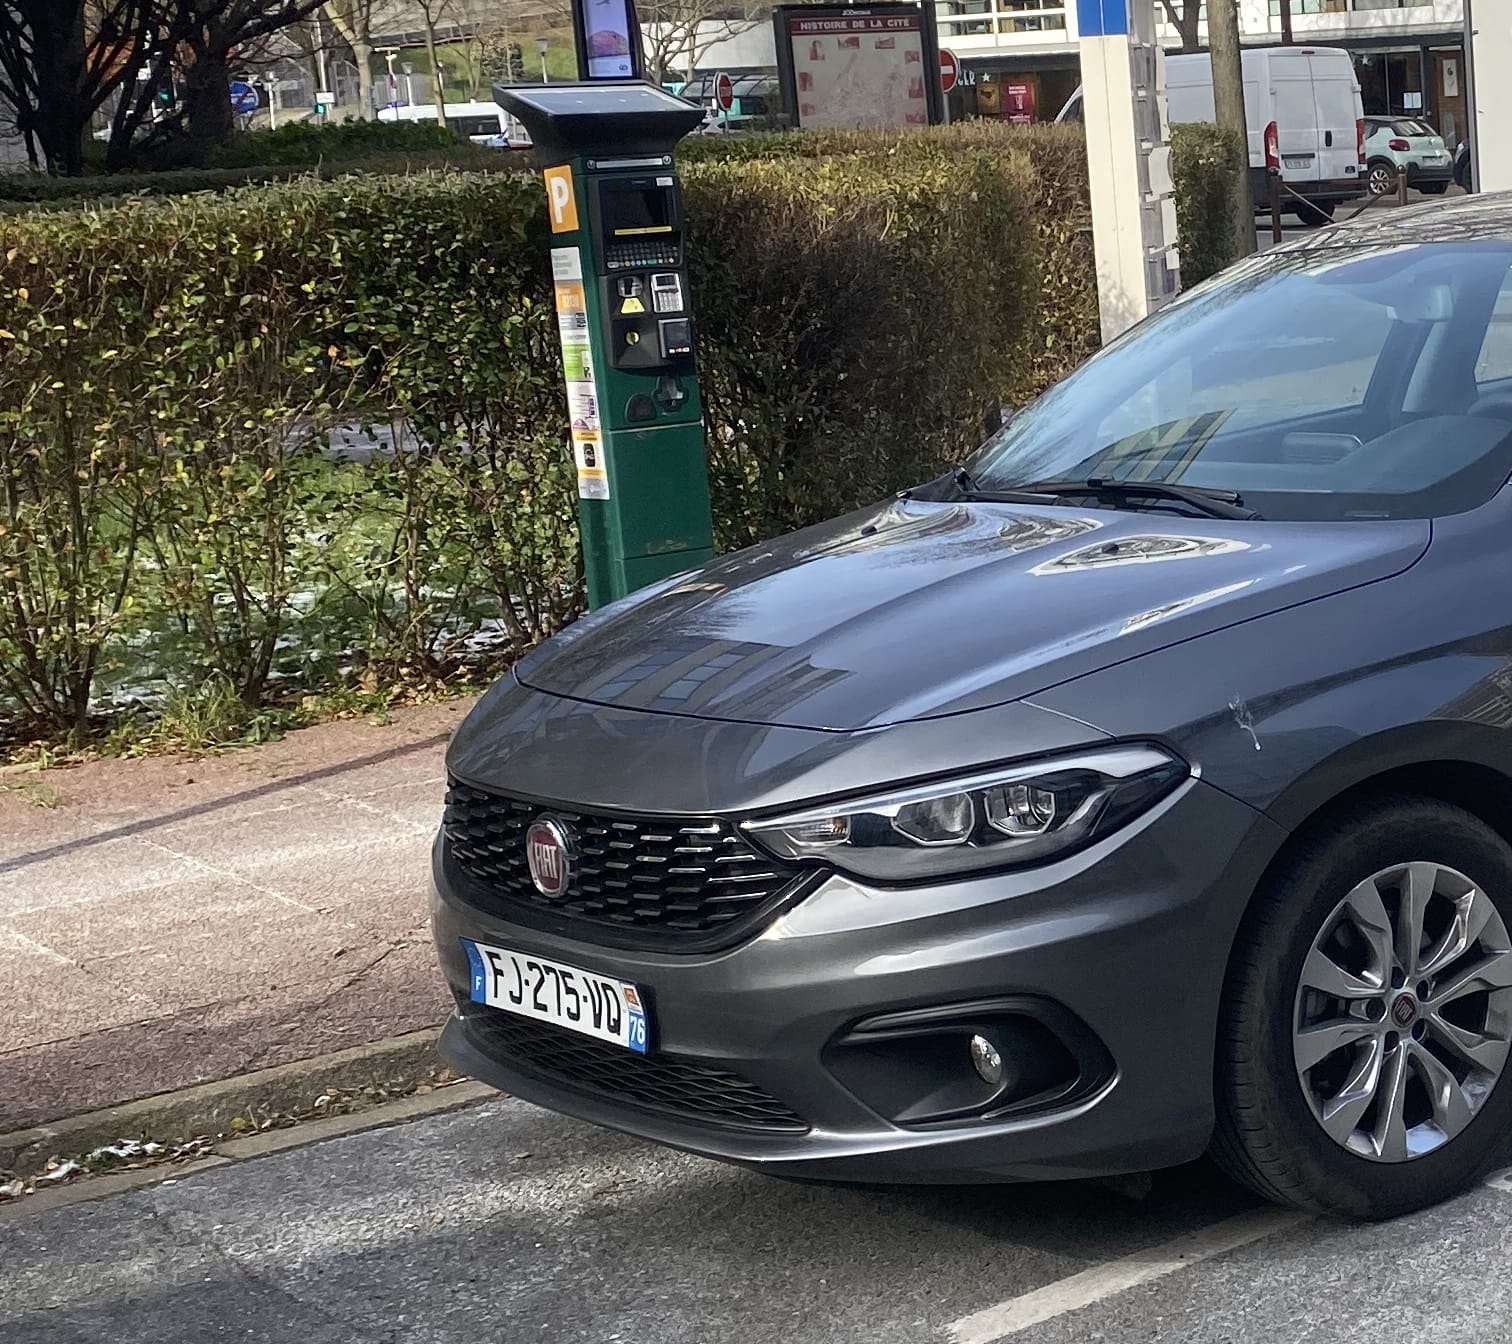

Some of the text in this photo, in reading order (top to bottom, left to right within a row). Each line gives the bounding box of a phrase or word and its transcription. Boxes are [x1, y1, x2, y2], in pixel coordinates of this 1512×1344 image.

[800, 20, 848, 32] HISTOIRE
[852, 20, 866, 29] DE
[870, 18, 884, 28] LA
[551, 176, 569, 224] P
[534, 842, 558, 879] FIAT
[475, 975, 482, 991] F
[485, 950, 621, 1036] FJ-275-VQ
[630, 1017, 646, 1045] 76
